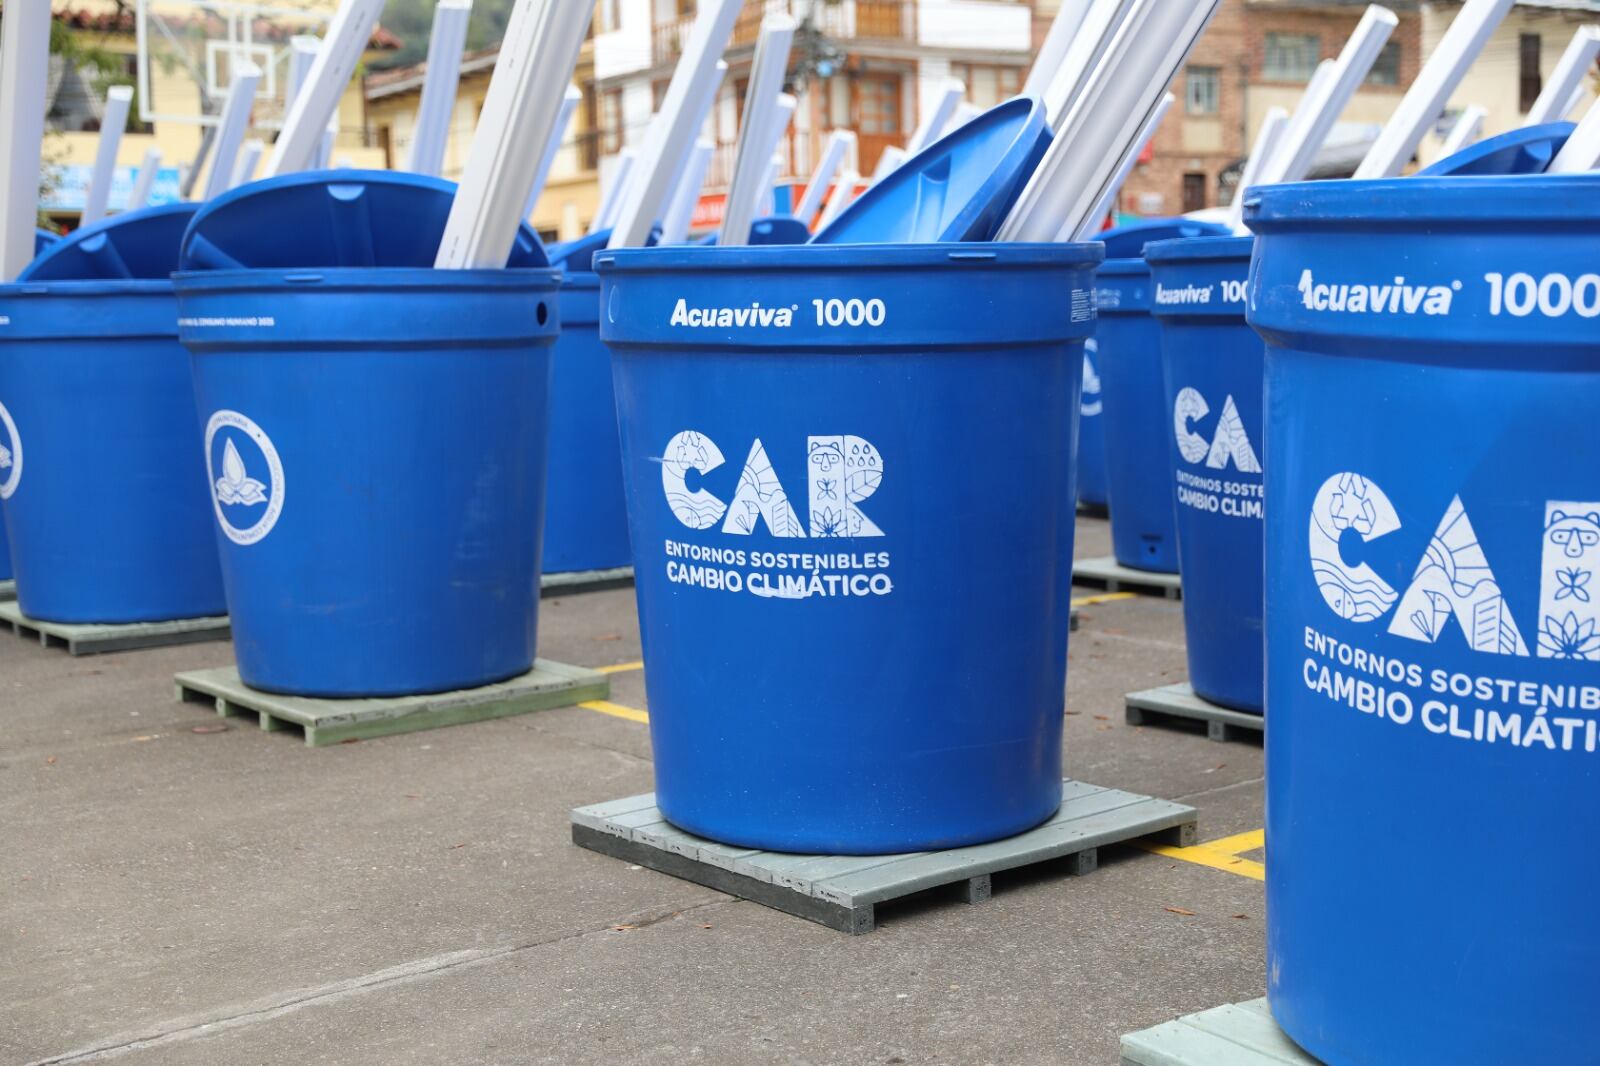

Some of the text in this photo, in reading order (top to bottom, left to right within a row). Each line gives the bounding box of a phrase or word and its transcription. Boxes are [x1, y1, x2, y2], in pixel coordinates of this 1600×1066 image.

[812, 298, 886, 328] 1000
[1484, 272, 1600, 318] 1000
[661, 430, 886, 539] CAR
[1177, 485, 1263, 520] CAMBIO CLIM
[665, 538, 891, 570] ENTORNOS SOSTENIBLES
[666, 560, 894, 600] CAMBIO CLIMÁTICO
[1304, 626, 1600, 711] ENTORNOS SOSTENIB
[1303, 657, 1600, 752] CAMBIO CLIMÁTI
